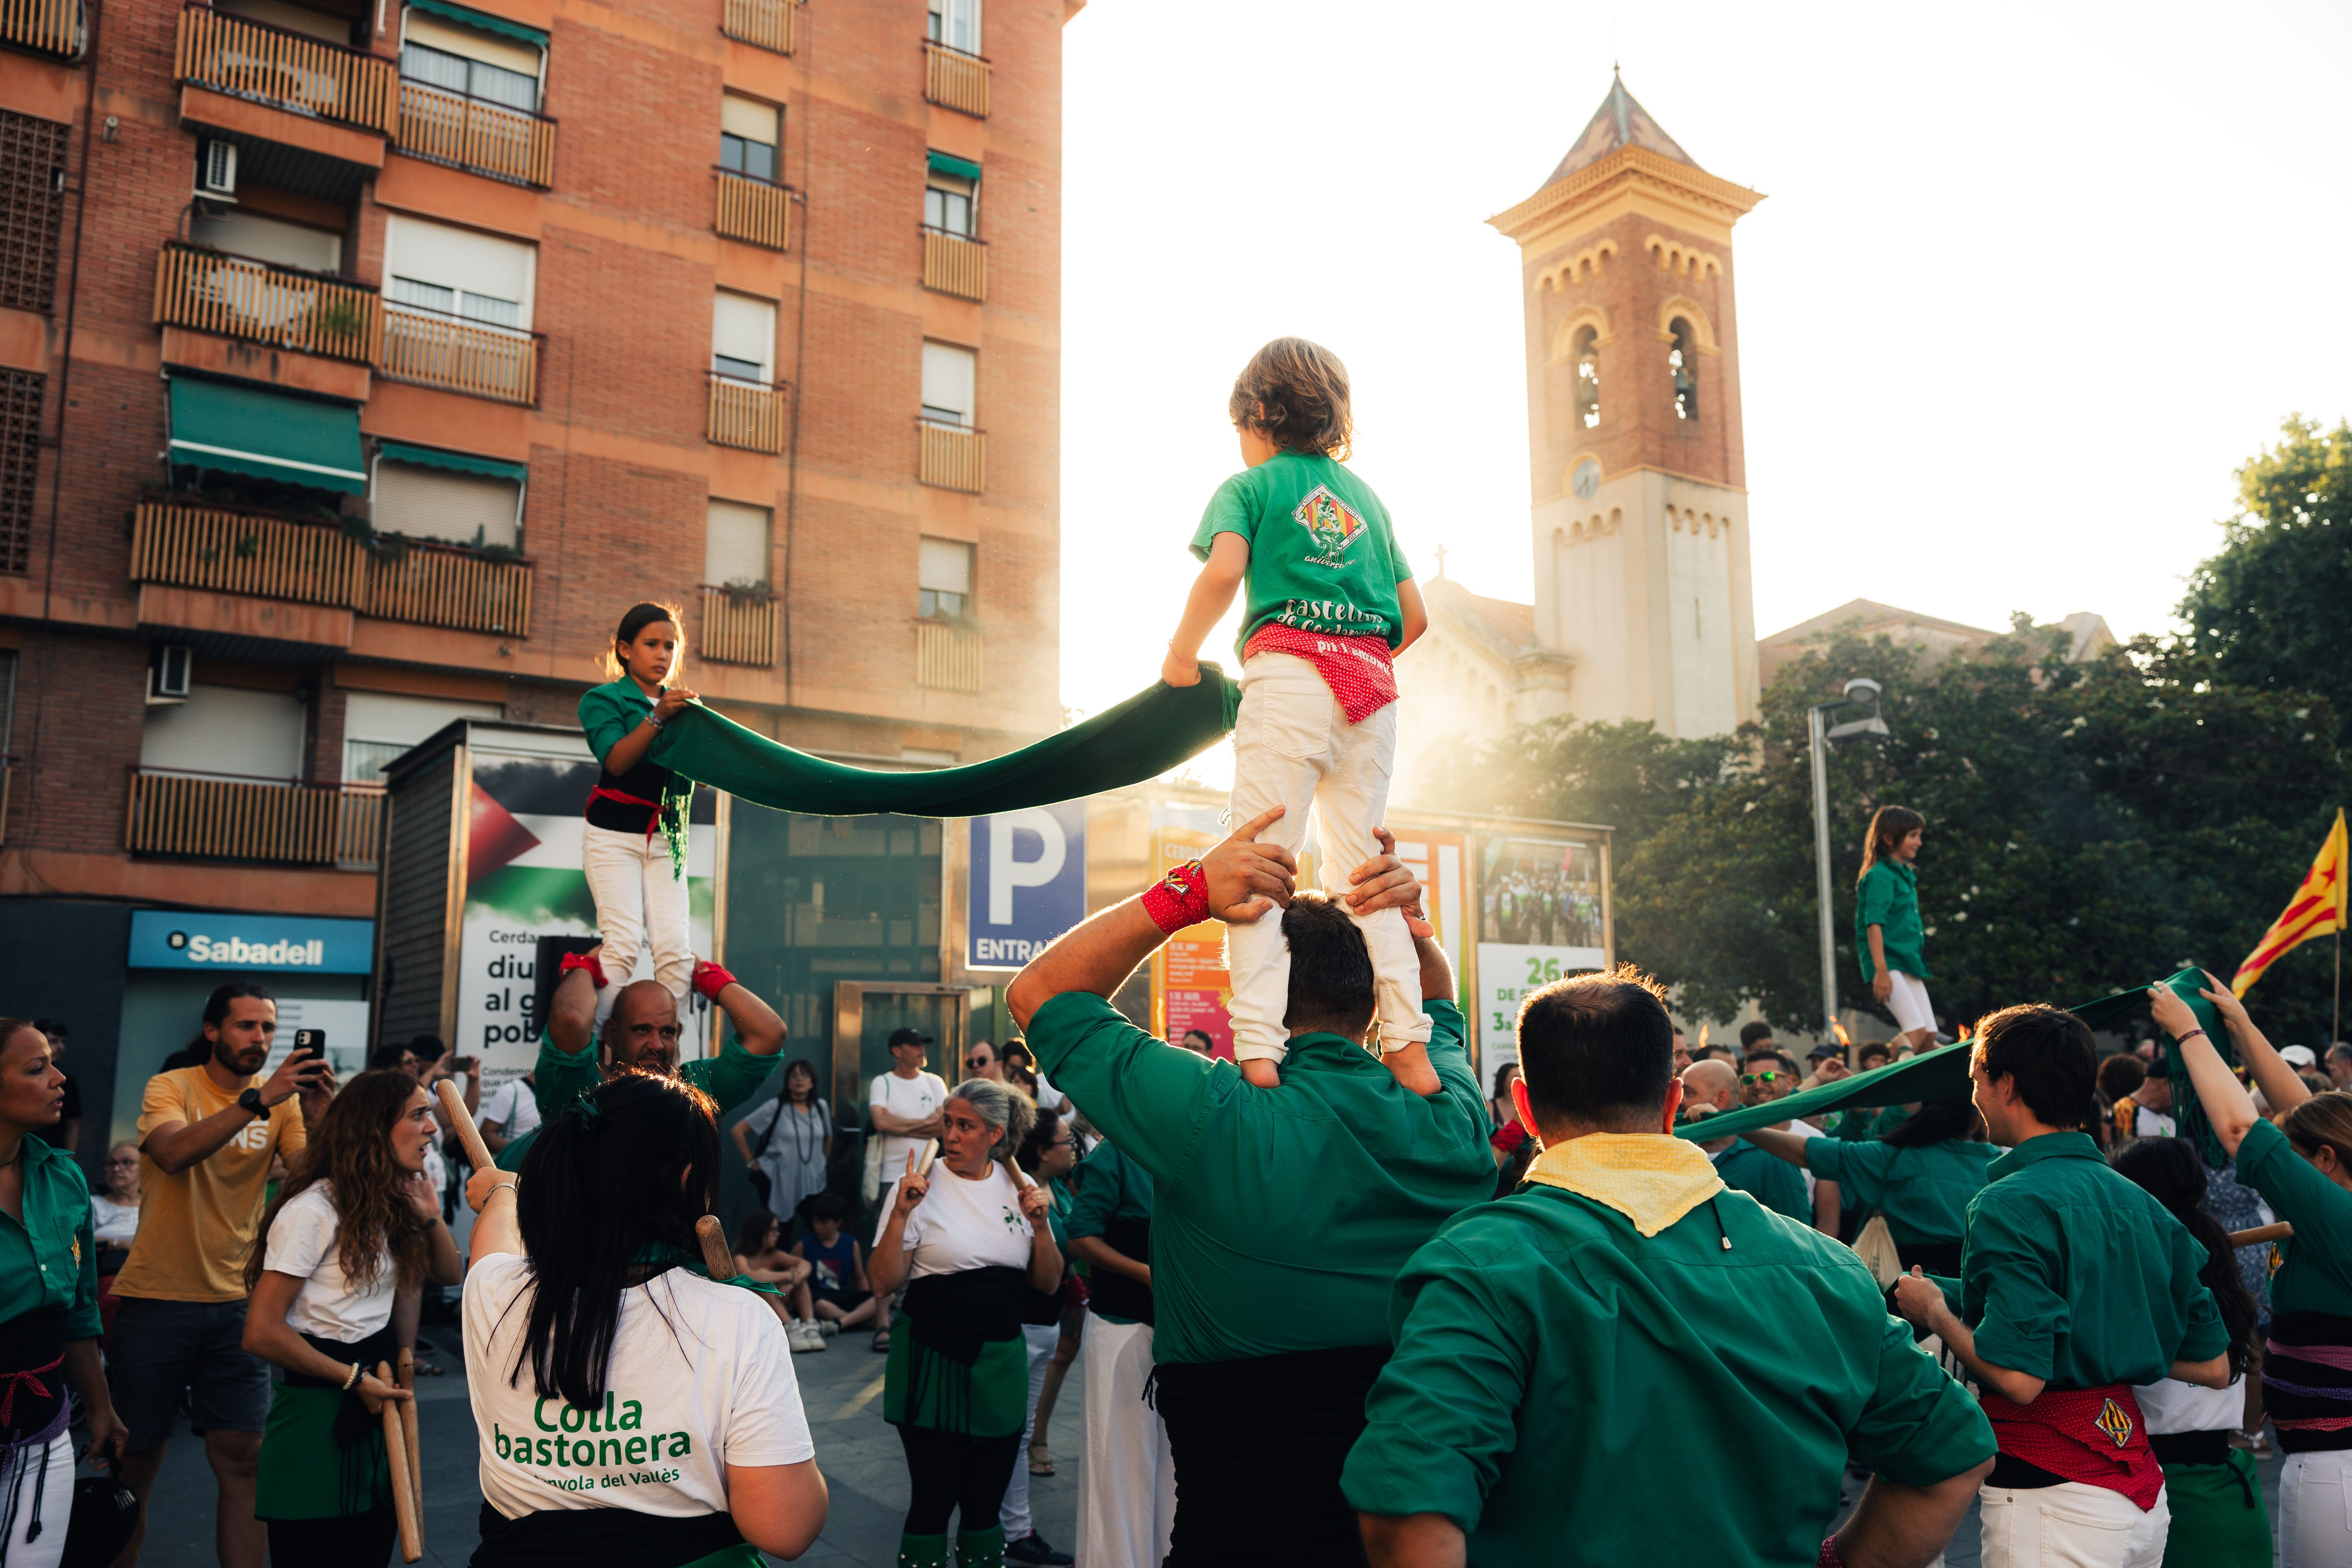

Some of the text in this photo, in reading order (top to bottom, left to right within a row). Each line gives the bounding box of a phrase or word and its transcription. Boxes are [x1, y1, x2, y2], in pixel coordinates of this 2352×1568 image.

[1347, 533, 1356, 542] 2023
[1318, 542, 1344, 564] 25
[1277, 613, 1298, 626] de
[1317, 641, 1338, 653] pit
[989, 808, 1066, 925] P
[489, 930, 539, 943] Cerda
[187, 935, 324, 965] Sabadell
[488, 955, 533, 979] diu
[1526, 956, 1560, 985] 26
[485, 988, 509, 1011] al
[1497, 988, 1515, 1001] DE
[226, 1127, 268, 1150] NS
[534, 1391, 642, 1433] Colla
[494, 1423, 691, 1467] bastonera
[601, 1474, 627, 1488] del
[629, 1468, 680, 1485] Vallès
